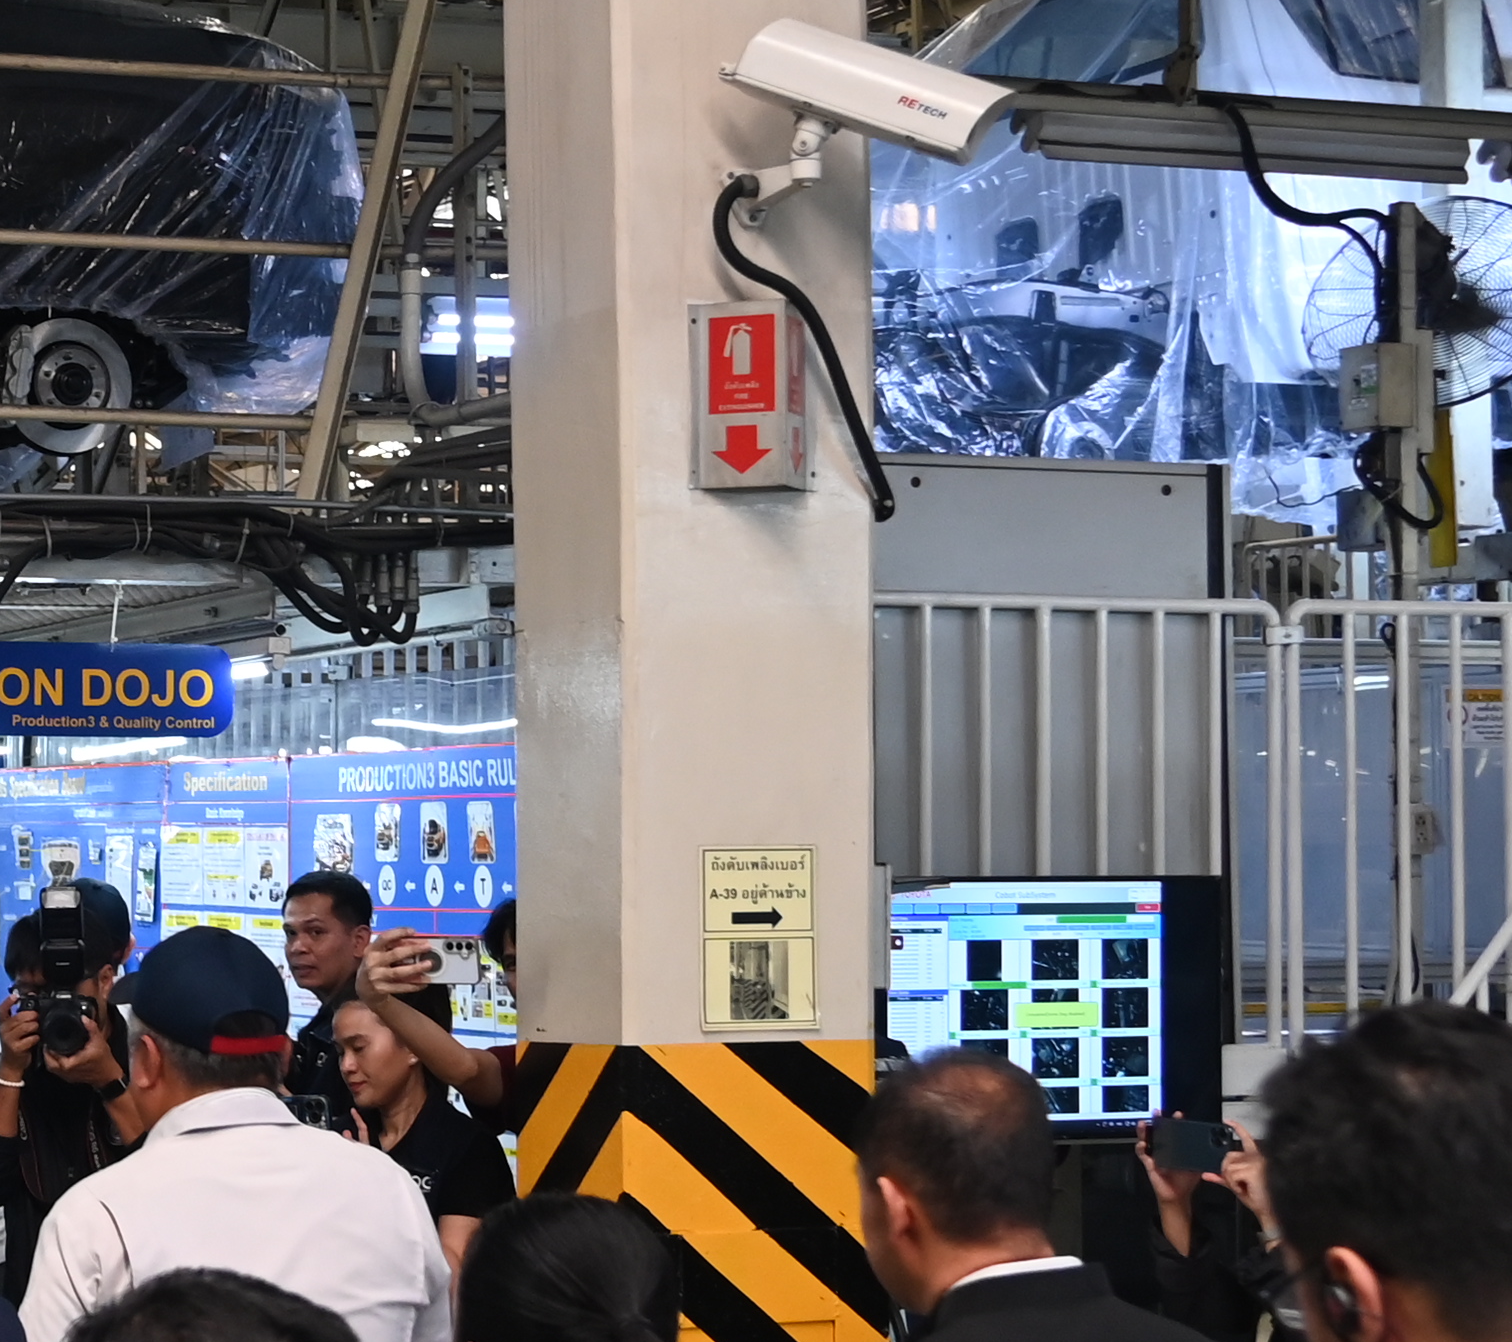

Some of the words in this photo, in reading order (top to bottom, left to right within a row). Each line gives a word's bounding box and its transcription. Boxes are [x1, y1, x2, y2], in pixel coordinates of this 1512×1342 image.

[897, 95, 948, 120] RETECH
[82, 668, 215, 708] DOJO
[11, 714, 96, 728] Production3
[99, 715, 110, 728] &
[112, 715, 161, 731] Quality
[164, 715, 215, 729] Control
[183, 771, 268, 796] Specification
[338, 763, 435, 793] PRODUCTION3
[438, 760, 484, 789] BASIC
[711, 854, 807, 872] ถังดับเพลิงเบอร์
[430, 877, 439, 893] A
[479, 877, 487, 894] T
[709, 888, 738, 900] A-39
[741, 882, 807, 905] อยู่ด้านข้าง
